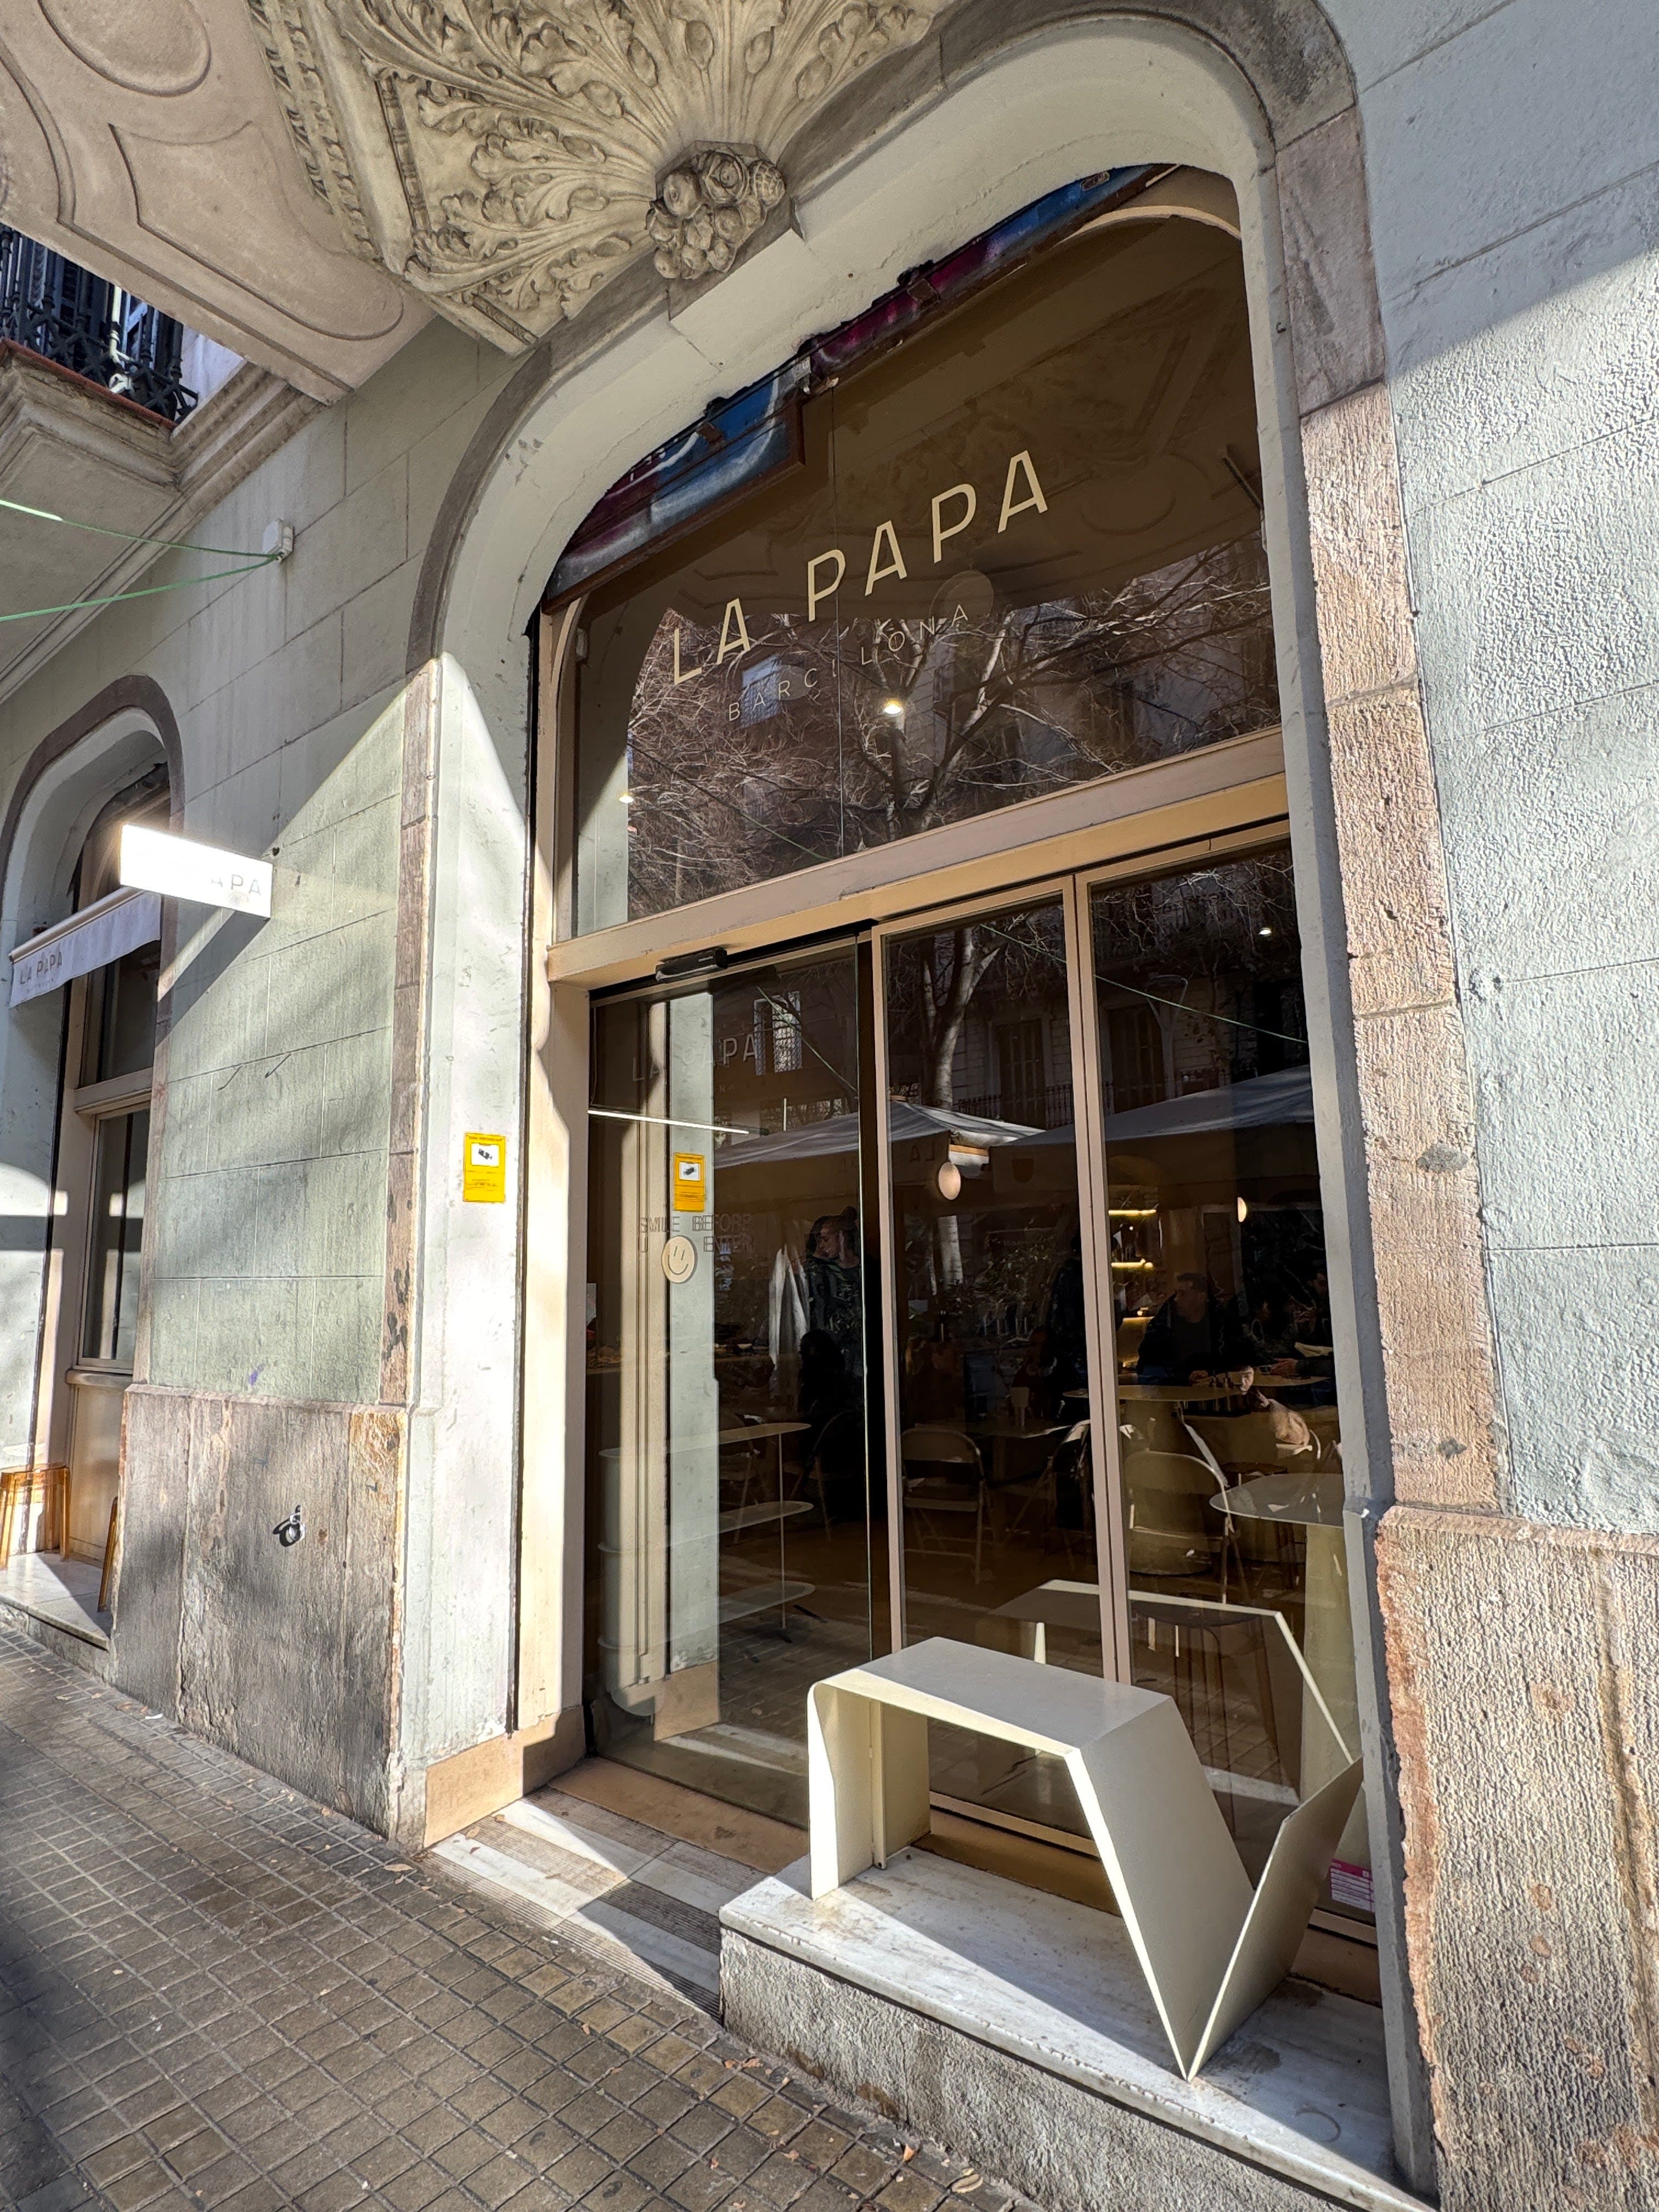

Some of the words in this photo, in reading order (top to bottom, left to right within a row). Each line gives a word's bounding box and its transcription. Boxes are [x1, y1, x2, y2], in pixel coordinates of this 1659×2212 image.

[674, 598, 752, 685] LA
[808, 449, 1048, 622] PAPA
[20, 966, 32, 984] LA
[36, 951, 63, 978] PAPA
[640, 1215, 681, 1233] SMILE
